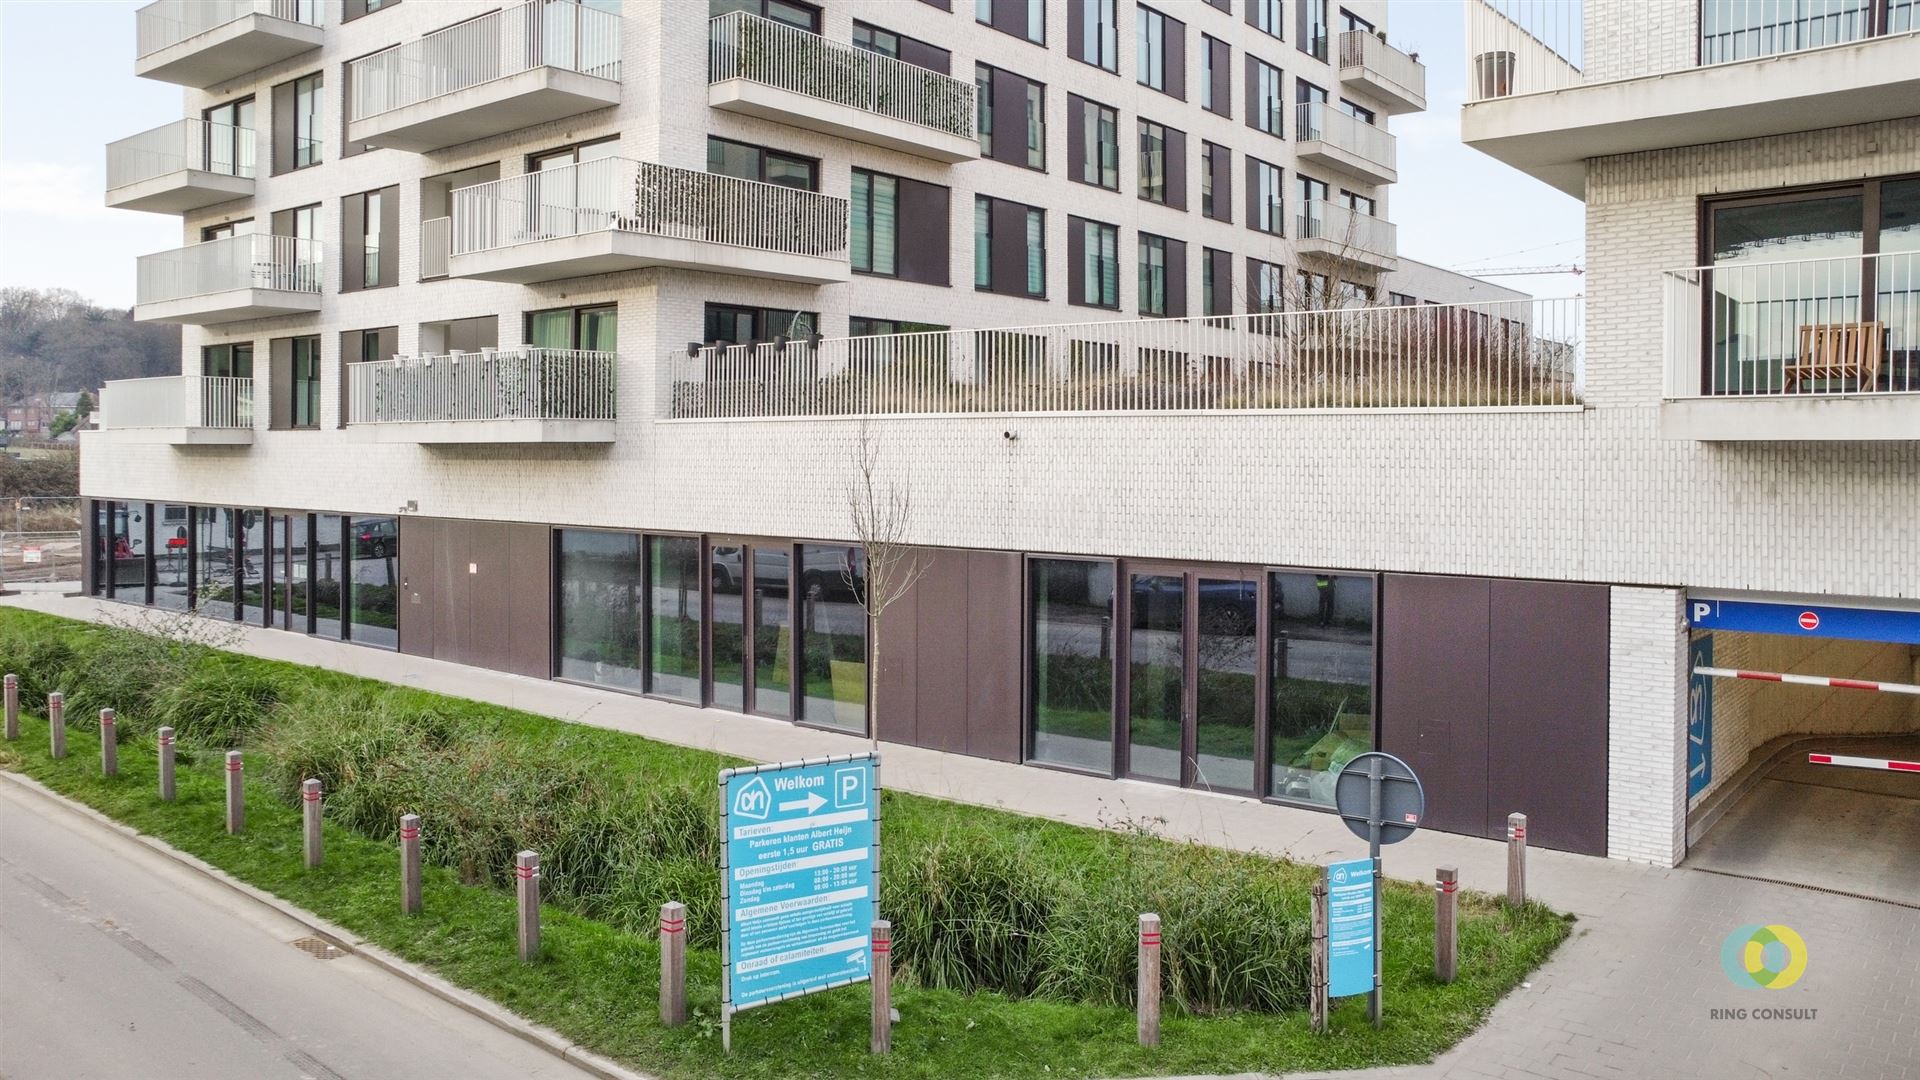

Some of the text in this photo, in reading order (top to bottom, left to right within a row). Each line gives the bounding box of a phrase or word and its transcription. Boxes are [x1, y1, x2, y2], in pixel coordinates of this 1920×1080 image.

[1694, 603, 1710, 622] P
[775, 775, 824, 791] Welkom
[843, 776, 858, 799] P
[750, 825, 852, 848] Parkeren klanten Albert Heijn
[759, 838, 844, 860] eerste 1,5 uur GRATIS
[740, 904, 778, 918] Algemene
[741, 958, 768, 970] Onraad
[770, 955, 778, 964] of
